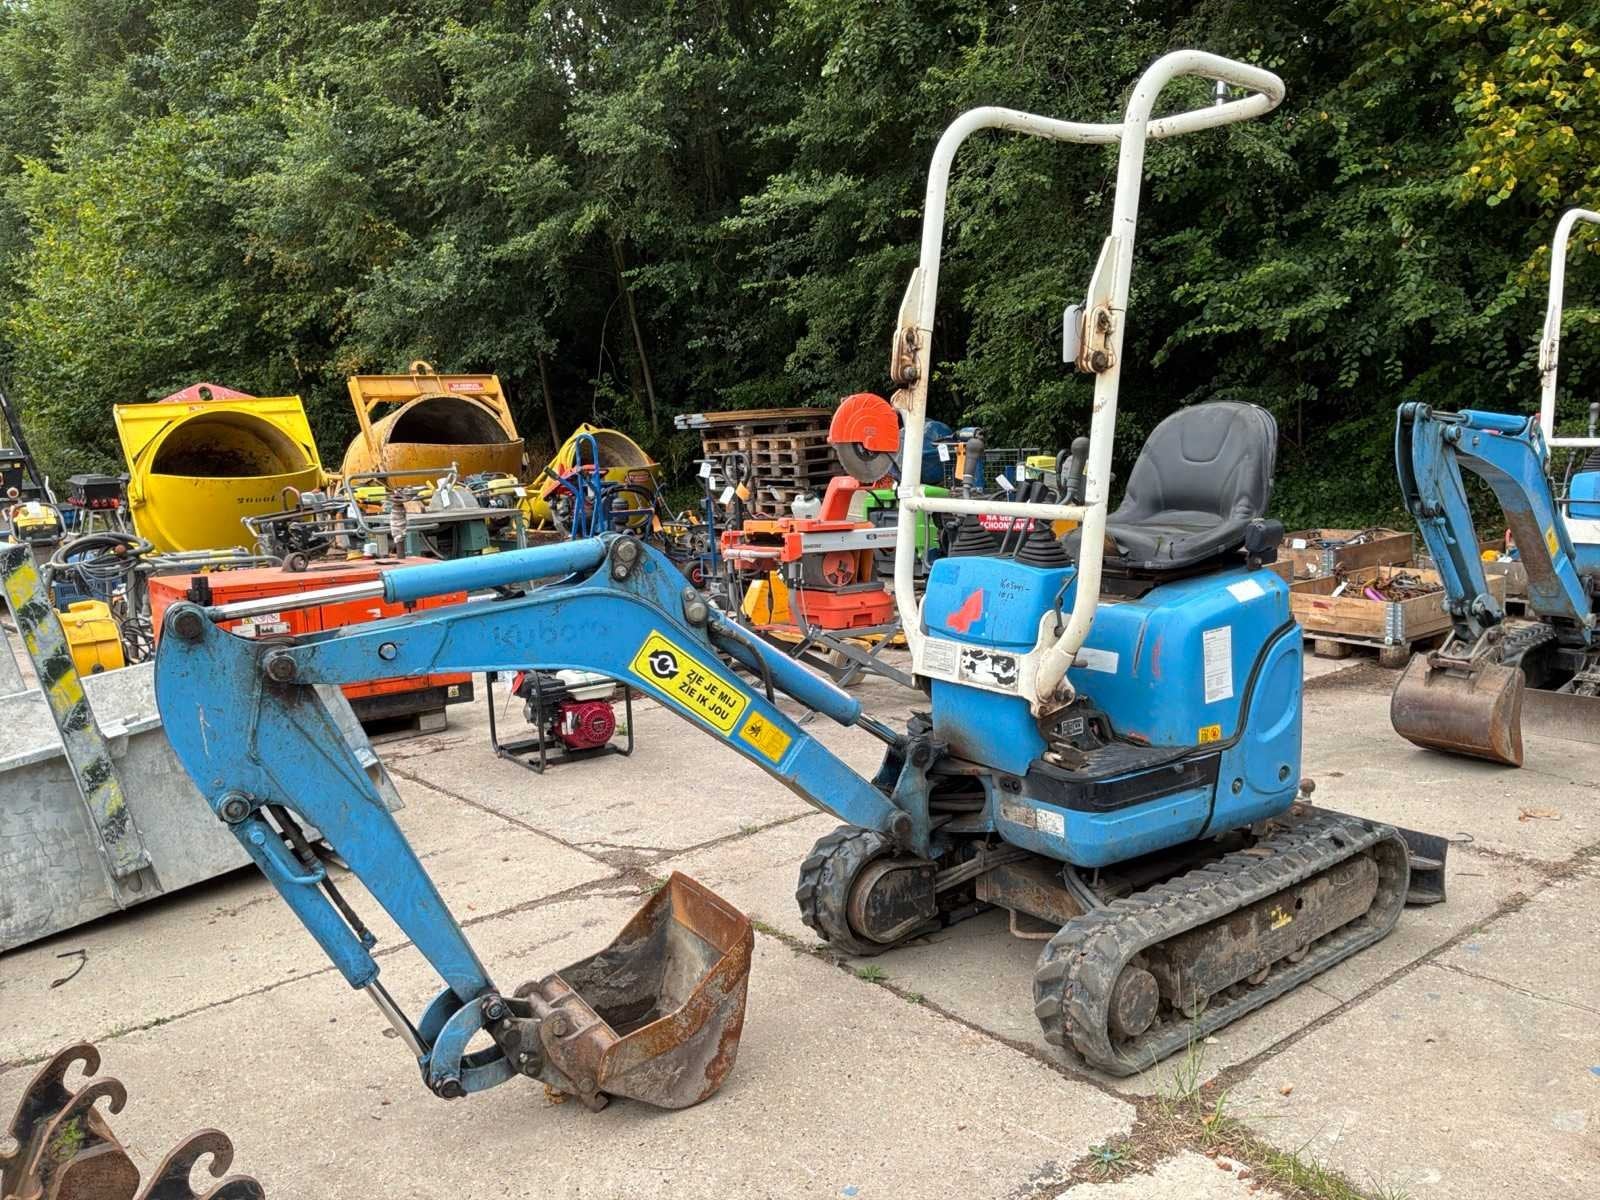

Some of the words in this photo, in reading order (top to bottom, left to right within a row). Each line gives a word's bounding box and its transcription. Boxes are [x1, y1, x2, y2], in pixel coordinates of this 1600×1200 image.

[679, 682, 697, 698] ZIE
[696, 694, 709, 707] IK
[708, 704, 729, 720] JOU
[686, 669, 704, 685] ZIE
[704, 683, 718, 696] JE
[718, 691, 736, 708] MIJ
